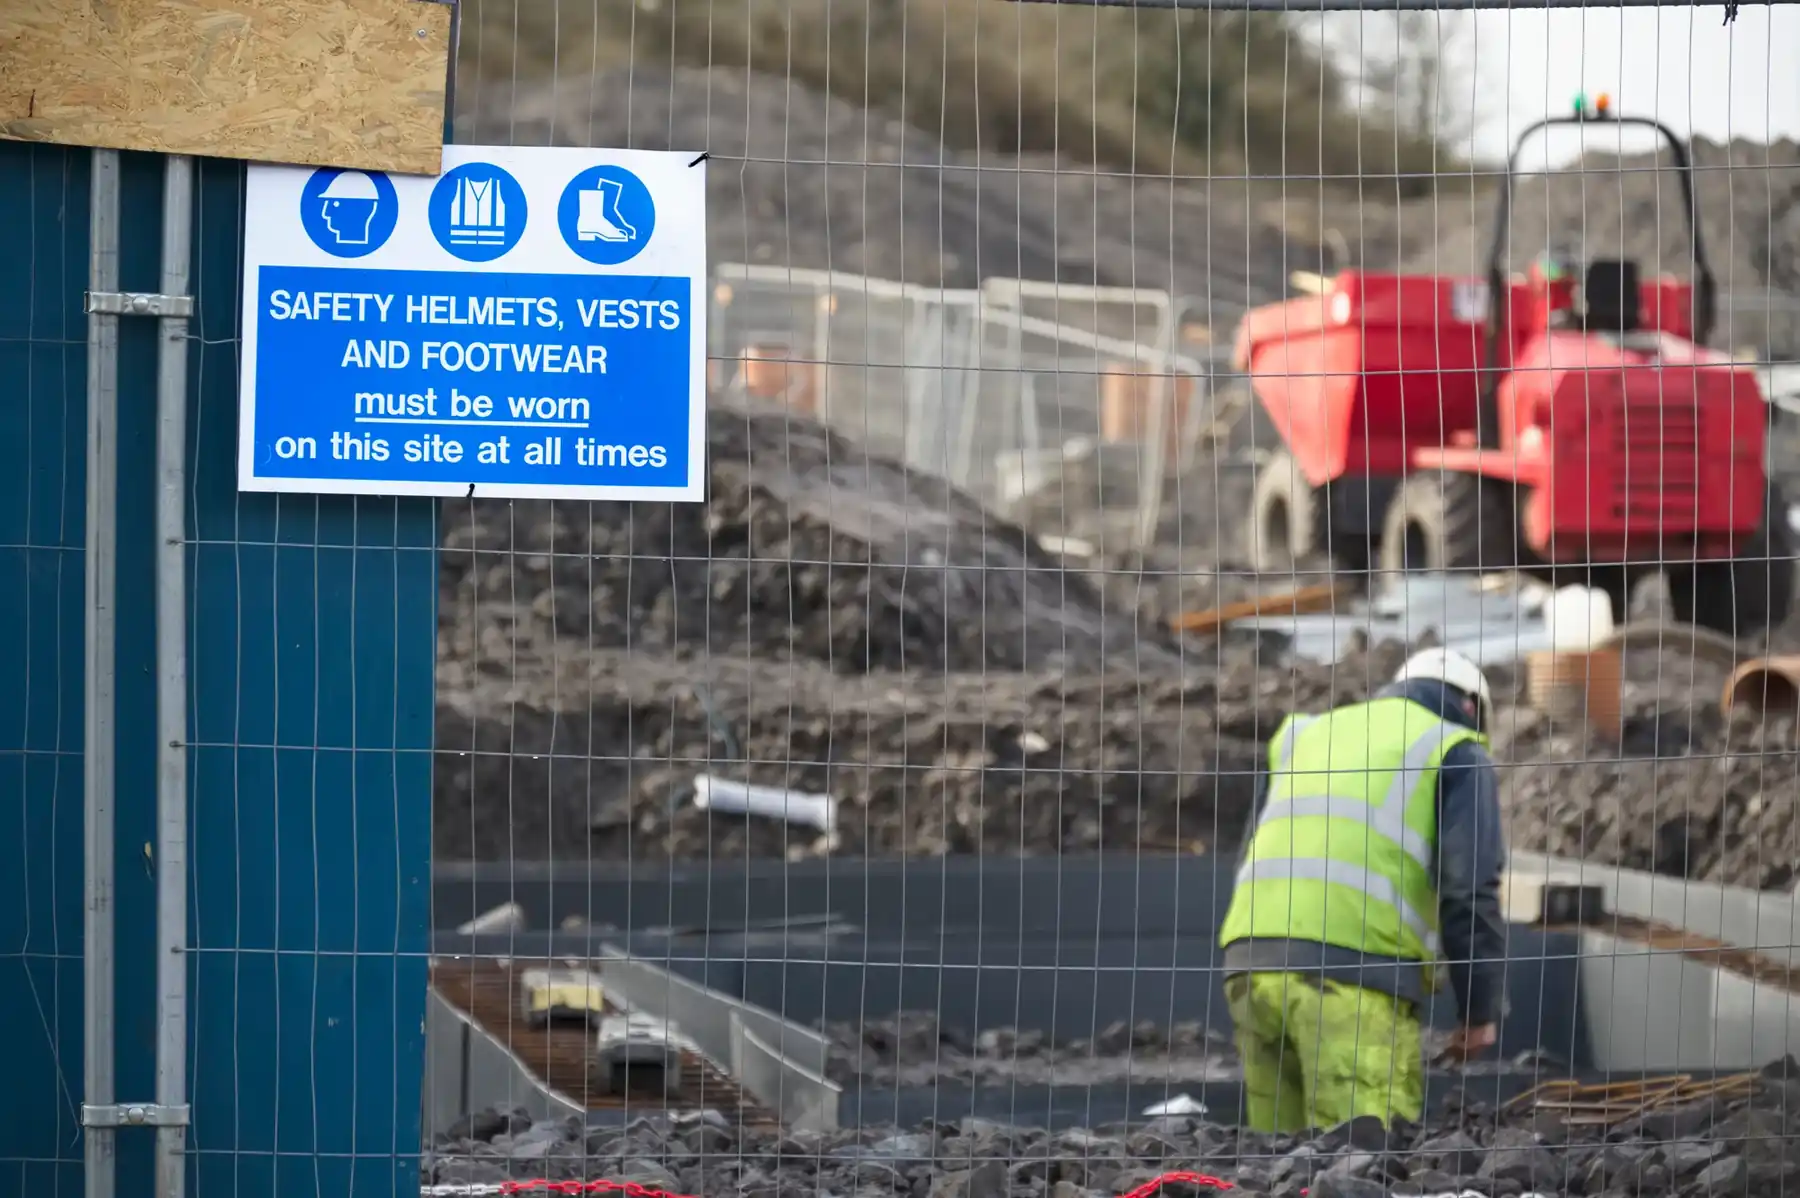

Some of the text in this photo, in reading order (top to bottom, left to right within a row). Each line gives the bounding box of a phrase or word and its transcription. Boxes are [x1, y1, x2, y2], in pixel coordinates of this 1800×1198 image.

[270, 290, 679, 330] SAFETY HELMETS, VESTS
[342, 340, 606, 373] AND FOOTWEAR
[356, 388, 589, 419] must be worn
[276, 432, 666, 467] on this site at all times
